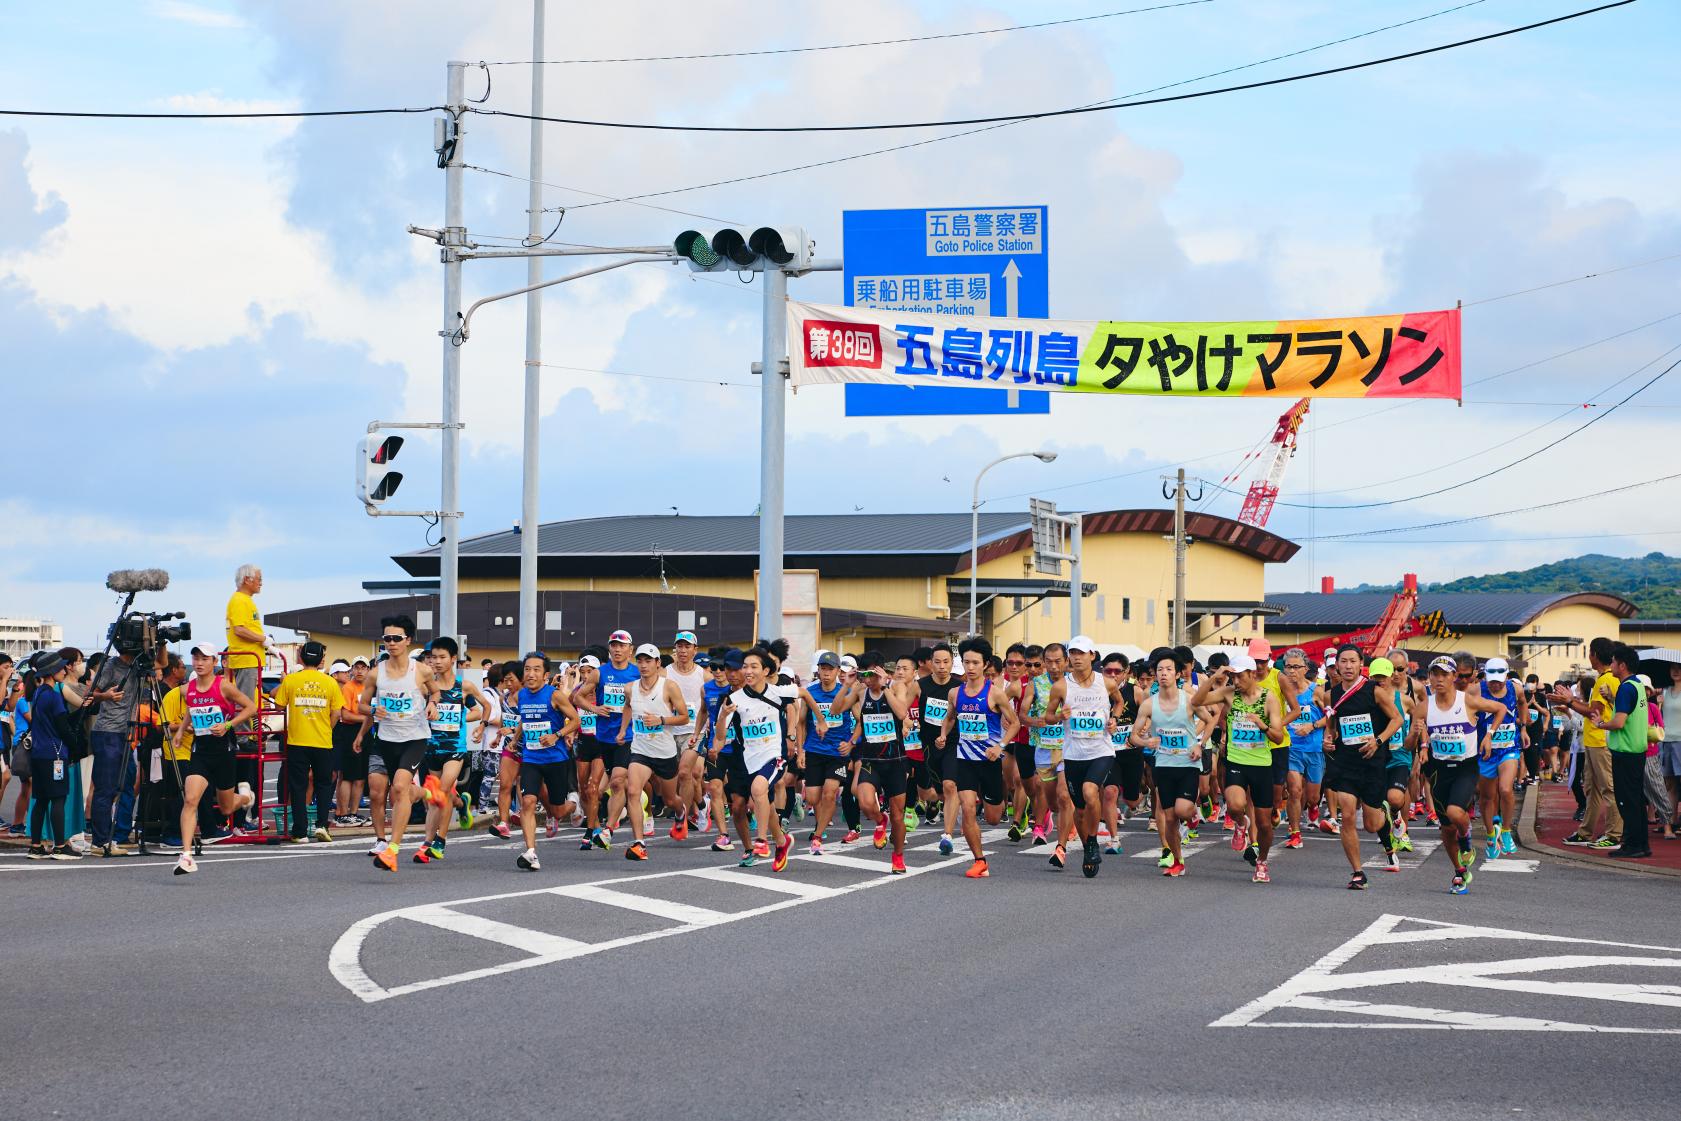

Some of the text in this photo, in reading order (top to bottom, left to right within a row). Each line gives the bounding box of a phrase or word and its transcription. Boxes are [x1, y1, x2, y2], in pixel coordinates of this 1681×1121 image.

[929, 212, 1038, 237] 五島警察署
[935, 238, 1033, 253] Goto Police Station
[857, 277, 988, 302] 乗船用駐車場
[870, 304, 974, 316] kation Parking
[808, 327, 876, 363] 第38回
[894, 323, 1079, 387] 五島列島
[382, 698, 411, 710] 1295
[926, 706, 948, 717] 207
[193, 713, 222, 726] 1196
[1072, 718, 1102, 729] 1090
[745, 723, 773, 737] 1061
[865, 721, 894, 734] 1550
[960, 720, 987, 732] 1222
[1042, 726, 1064, 737] 269
[1342, 722, 1371, 736] 1588
[1233, 729, 1264, 741] 2221
[1433, 742, 1463, 753] 1021
